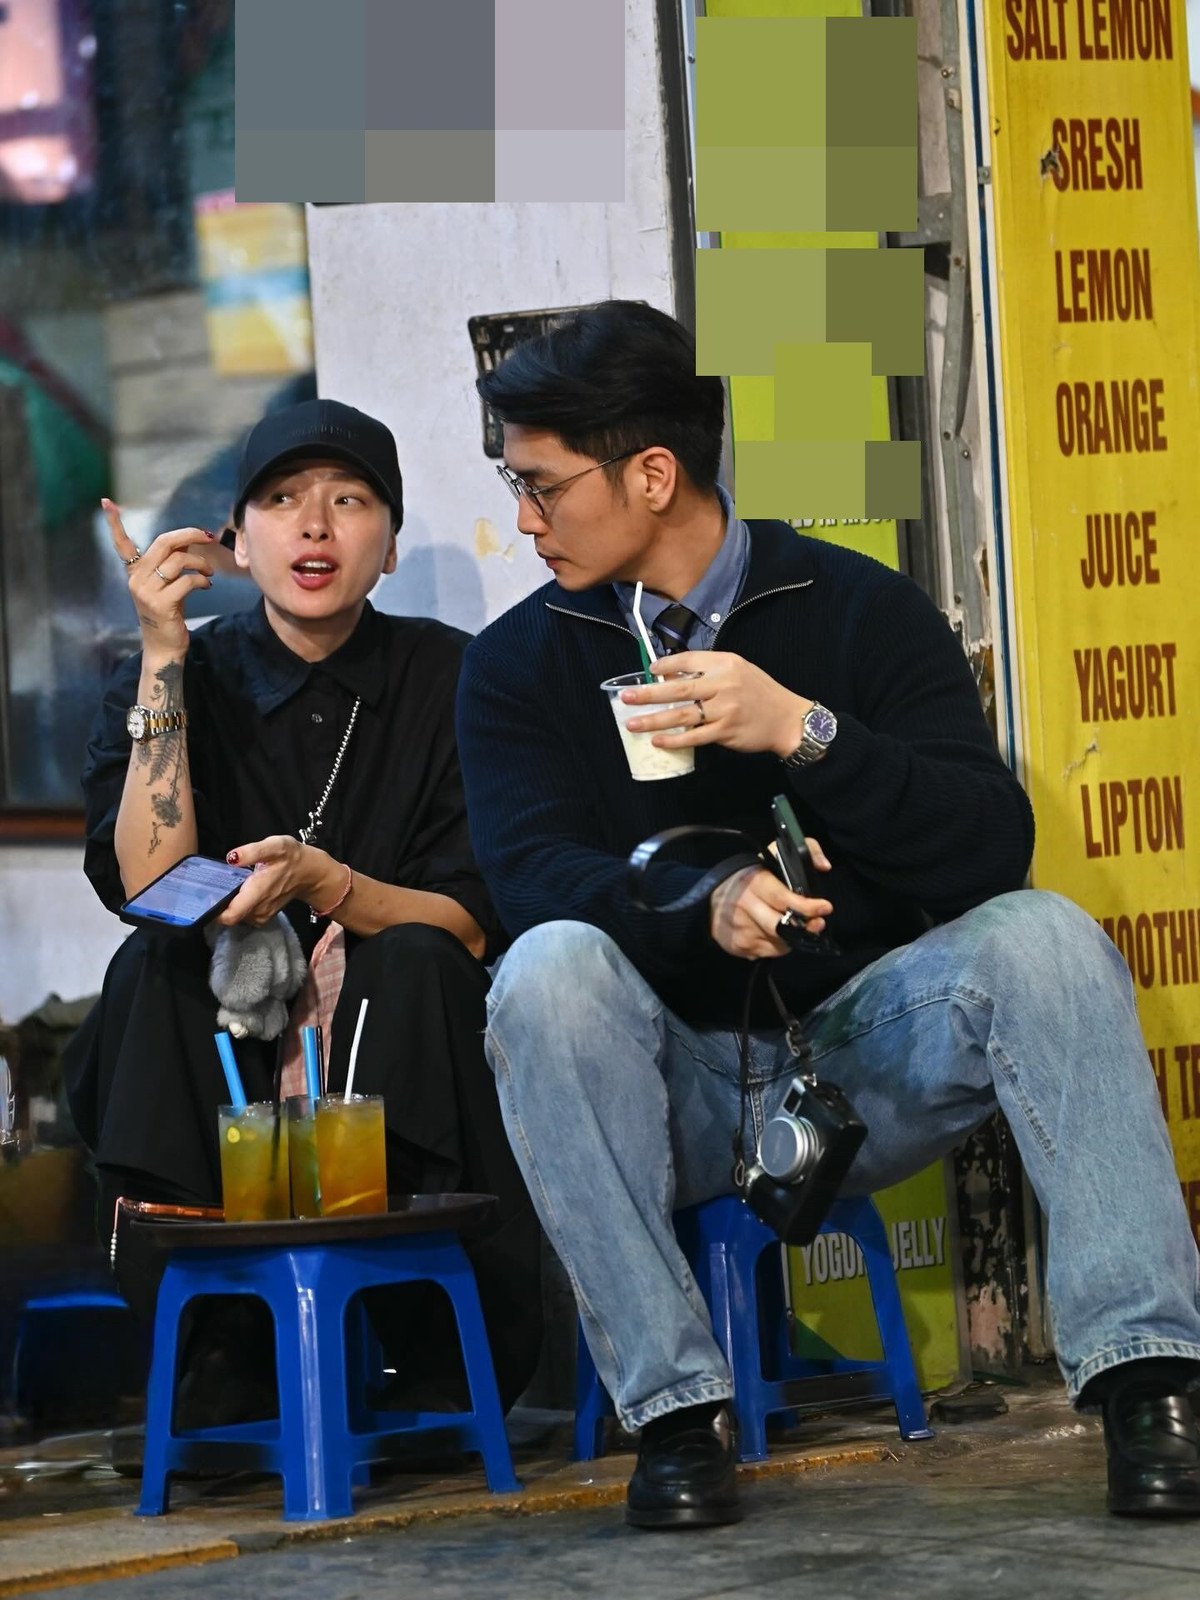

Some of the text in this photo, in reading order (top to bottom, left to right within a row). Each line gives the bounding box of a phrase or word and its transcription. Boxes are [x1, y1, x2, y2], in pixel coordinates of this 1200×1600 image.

[1005, 0, 1173, 61] SALT LEMON
[1052, 117, 1143, 192] SRESH
[1055, 248, 1153, 323] LEMON
[1056, 378, 1168, 457] ORANGE
[1080, 511, 1160, 589] JUICE
[1073, 643, 1177, 723] YAGURT
[1080, 776, 1185, 859] LIPTON
[1096, 908, 1200, 989] OOTHI
[801, 1216, 947, 1285] YOGU JELLY
